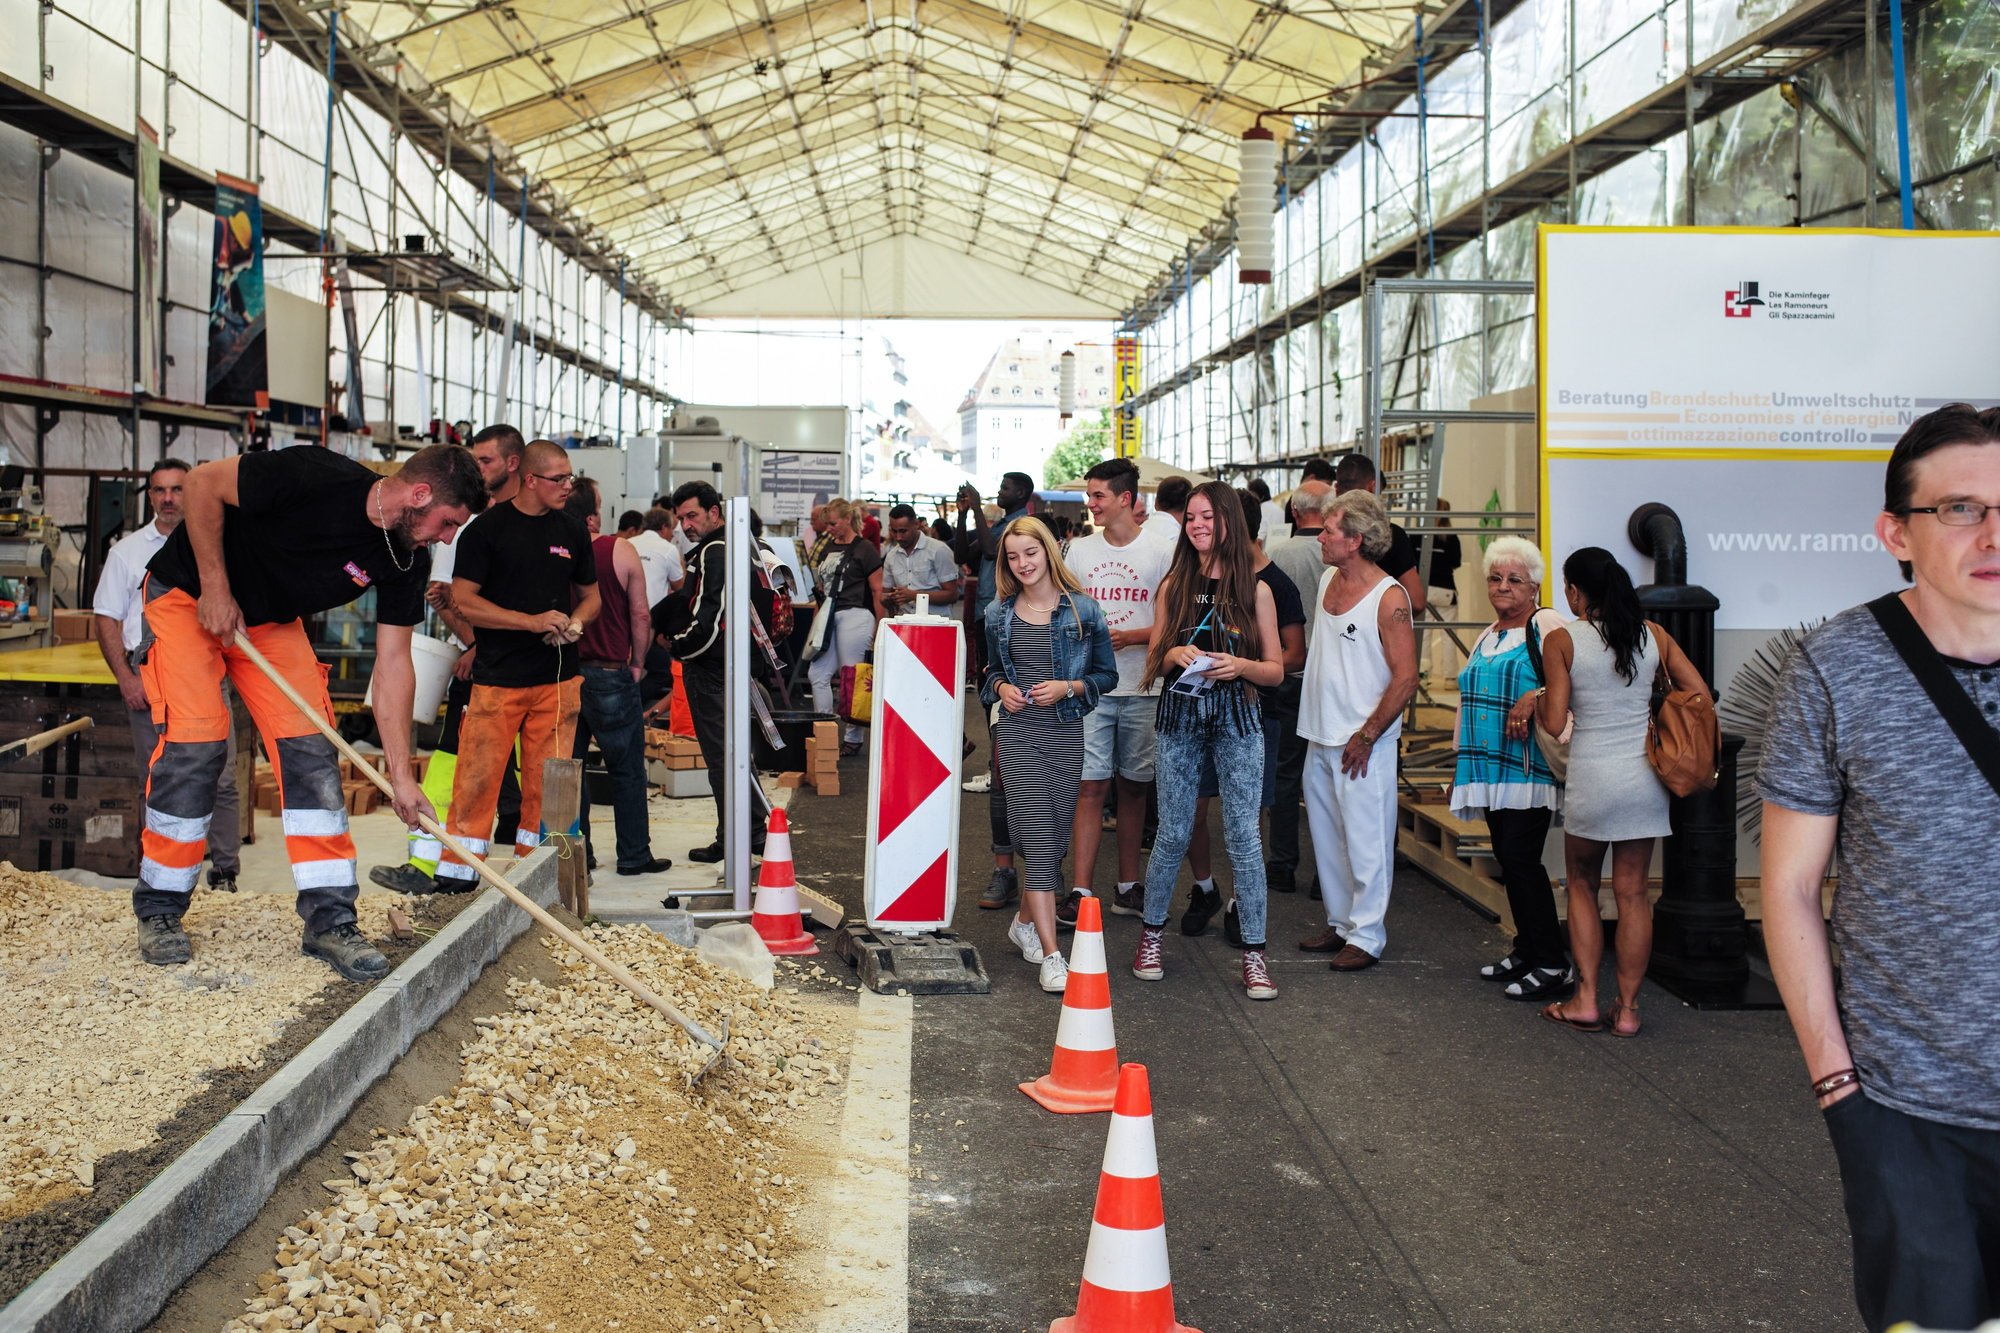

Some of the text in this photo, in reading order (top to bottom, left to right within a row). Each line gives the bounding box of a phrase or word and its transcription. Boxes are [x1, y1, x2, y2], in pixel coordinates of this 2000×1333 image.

[1785, 291, 1830, 300] Kaminfeger
[1782, 312, 1835, 320] Spazzacamini
[1684, 408, 1794, 425] Economies
[1088, 562, 1139, 580] SOUTHERN
[1083, 587, 1149, 602] LLISTER
[48, 817, 68, 829] SBB
